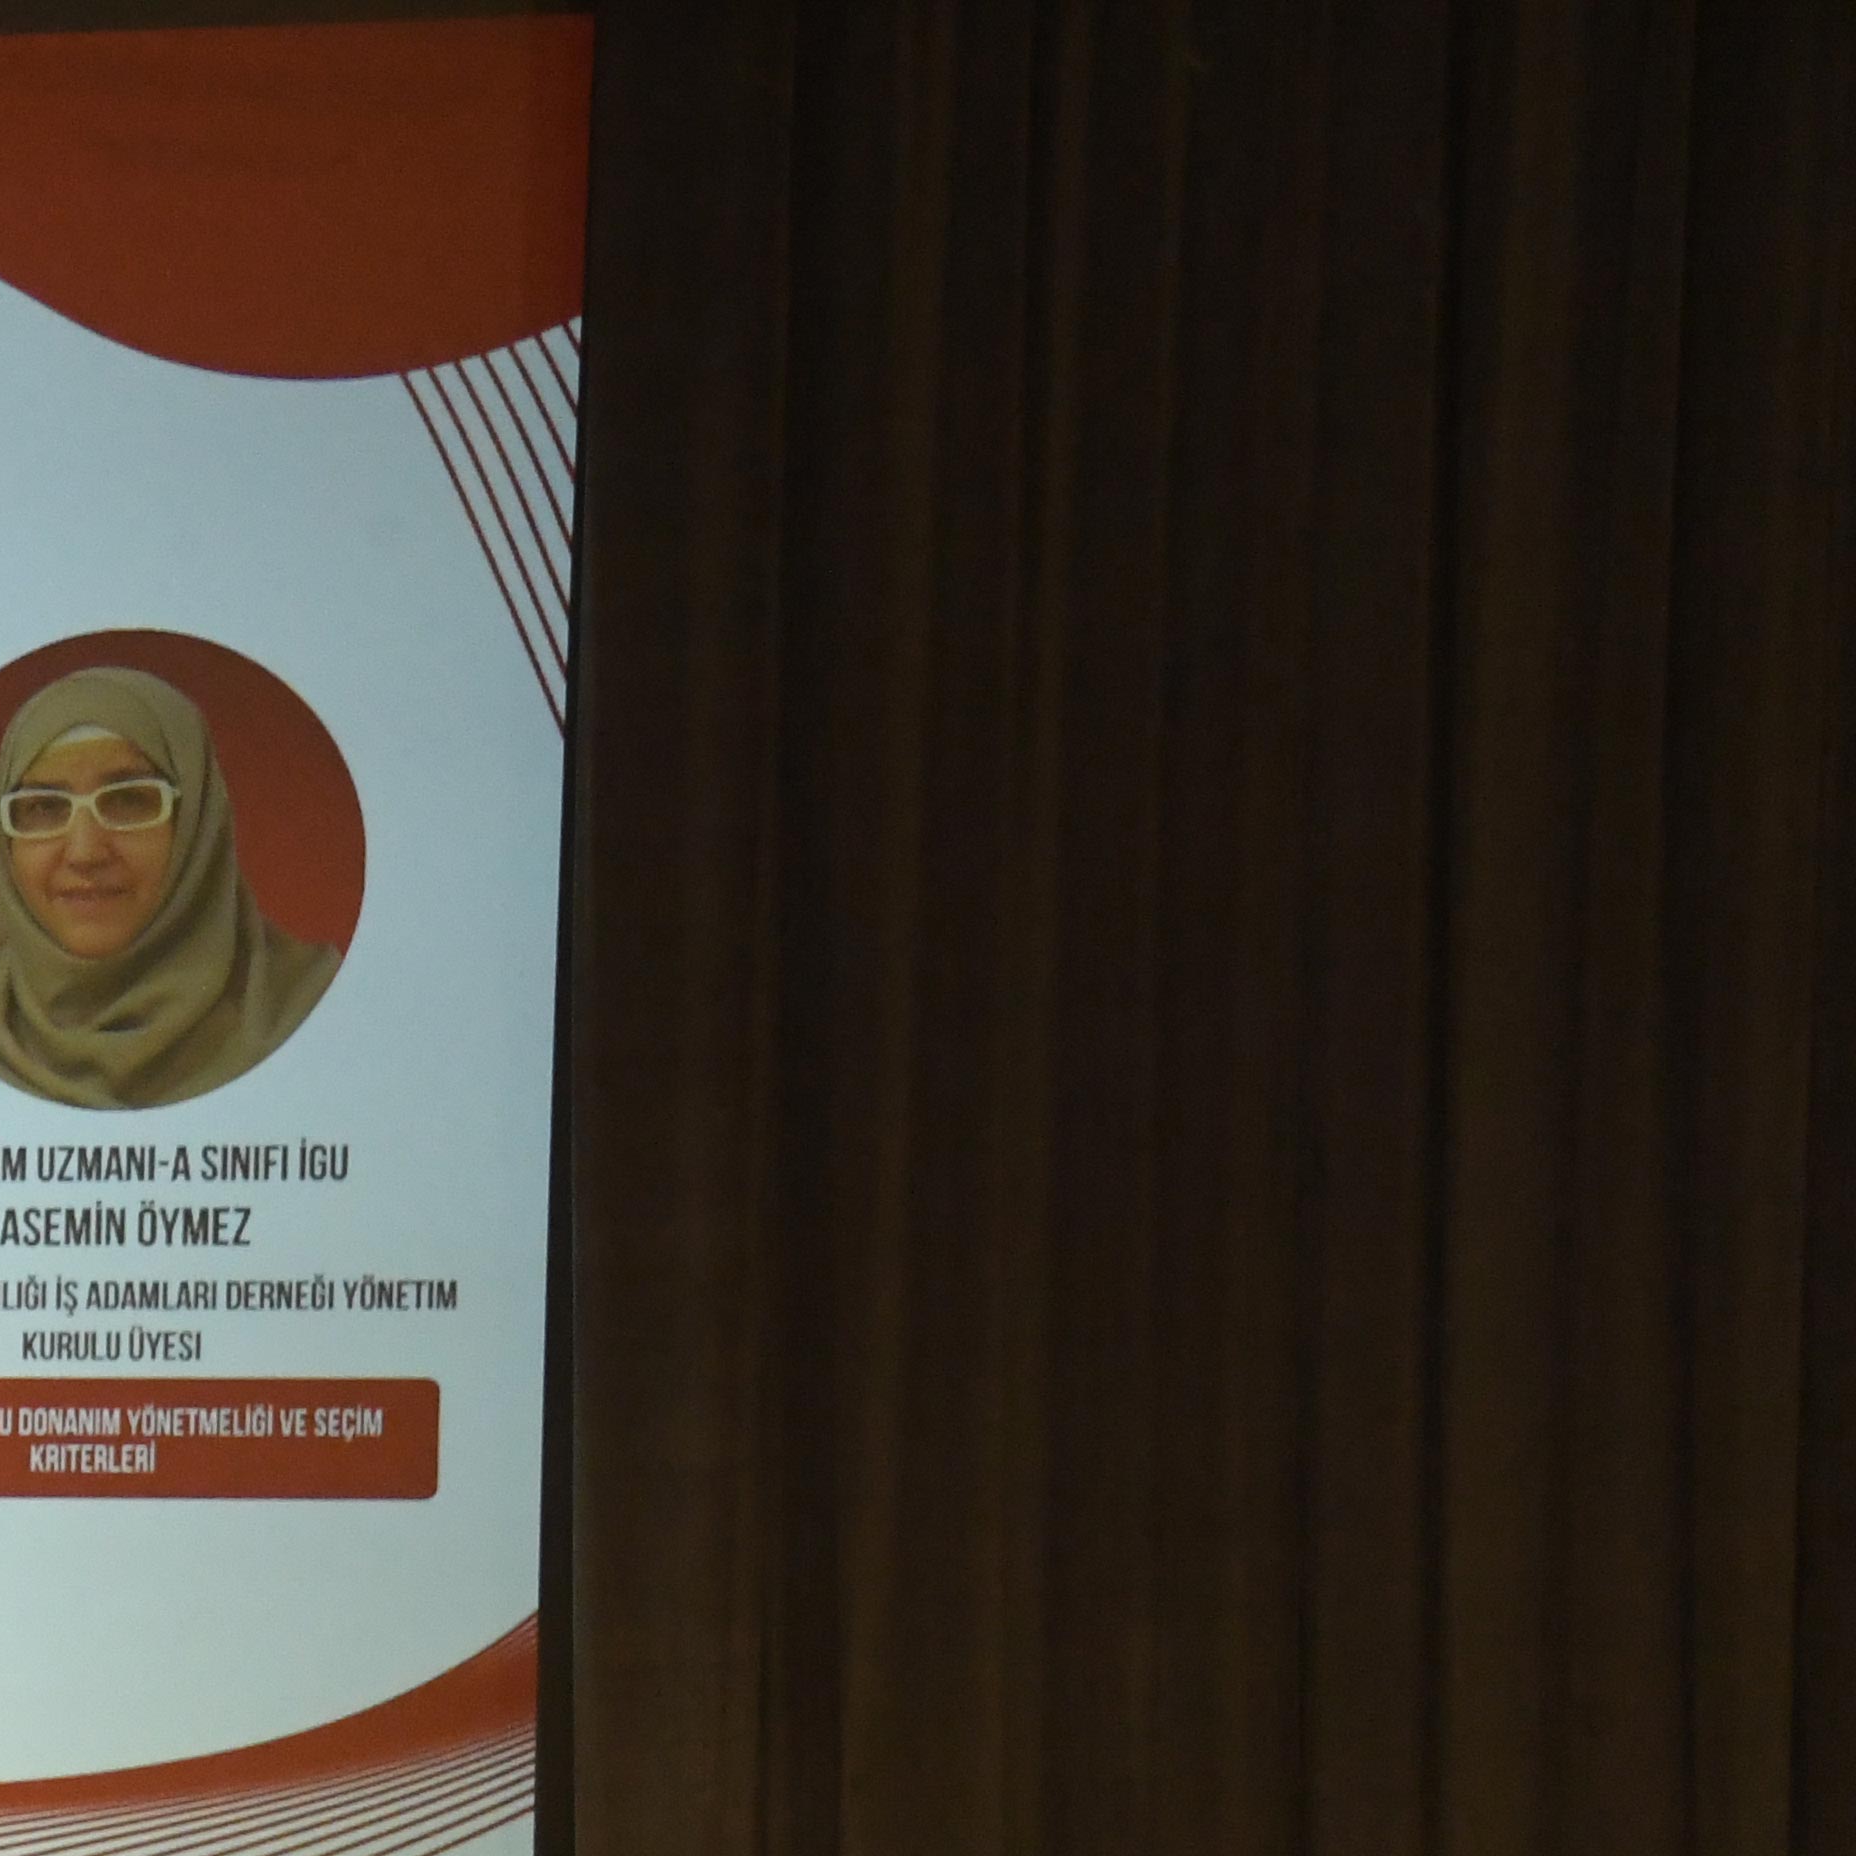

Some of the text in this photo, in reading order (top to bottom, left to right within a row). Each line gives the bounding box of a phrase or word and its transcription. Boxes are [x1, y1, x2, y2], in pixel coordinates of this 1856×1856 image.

[201, 1145, 289, 1181] SINIFI
[299, 1138, 349, 1181] İGU
[137, 1200, 251, 1247] ÖYMEZ
[55, 1276, 79, 1316] İŞ
[85, 1280, 218, 1310] ADAMLARI
[22, 1331, 121, 1361] KURULU
[18, 1406, 121, 1437] DONANIM
[127, 1402, 274, 1439] YÖNETMELİĞİ
[279, 1407, 307, 1438] VE
[314, 1406, 383, 1442] SEÇİM
